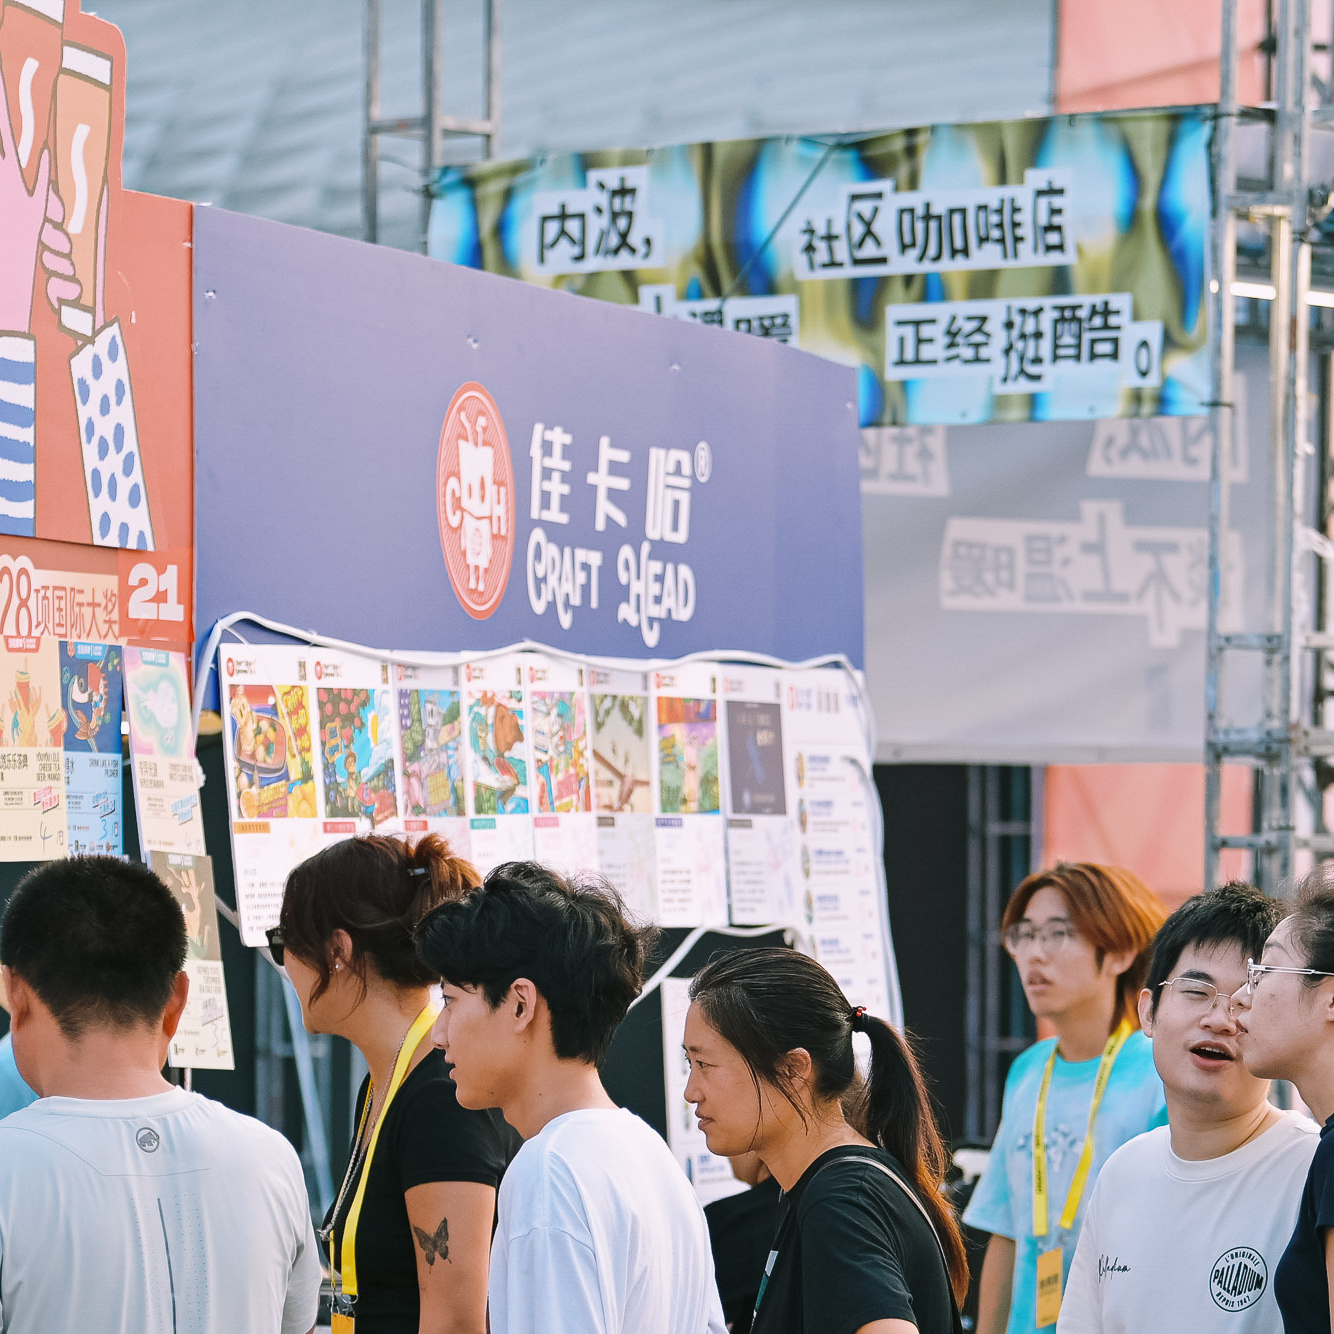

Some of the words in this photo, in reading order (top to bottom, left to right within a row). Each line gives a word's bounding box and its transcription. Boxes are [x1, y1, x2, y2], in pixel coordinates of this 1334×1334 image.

[801, 177, 1066, 270] 社区咖啡店
[127, 562, 185, 622] 21
[1212, 1261, 1265, 1299] PALLADIUM
